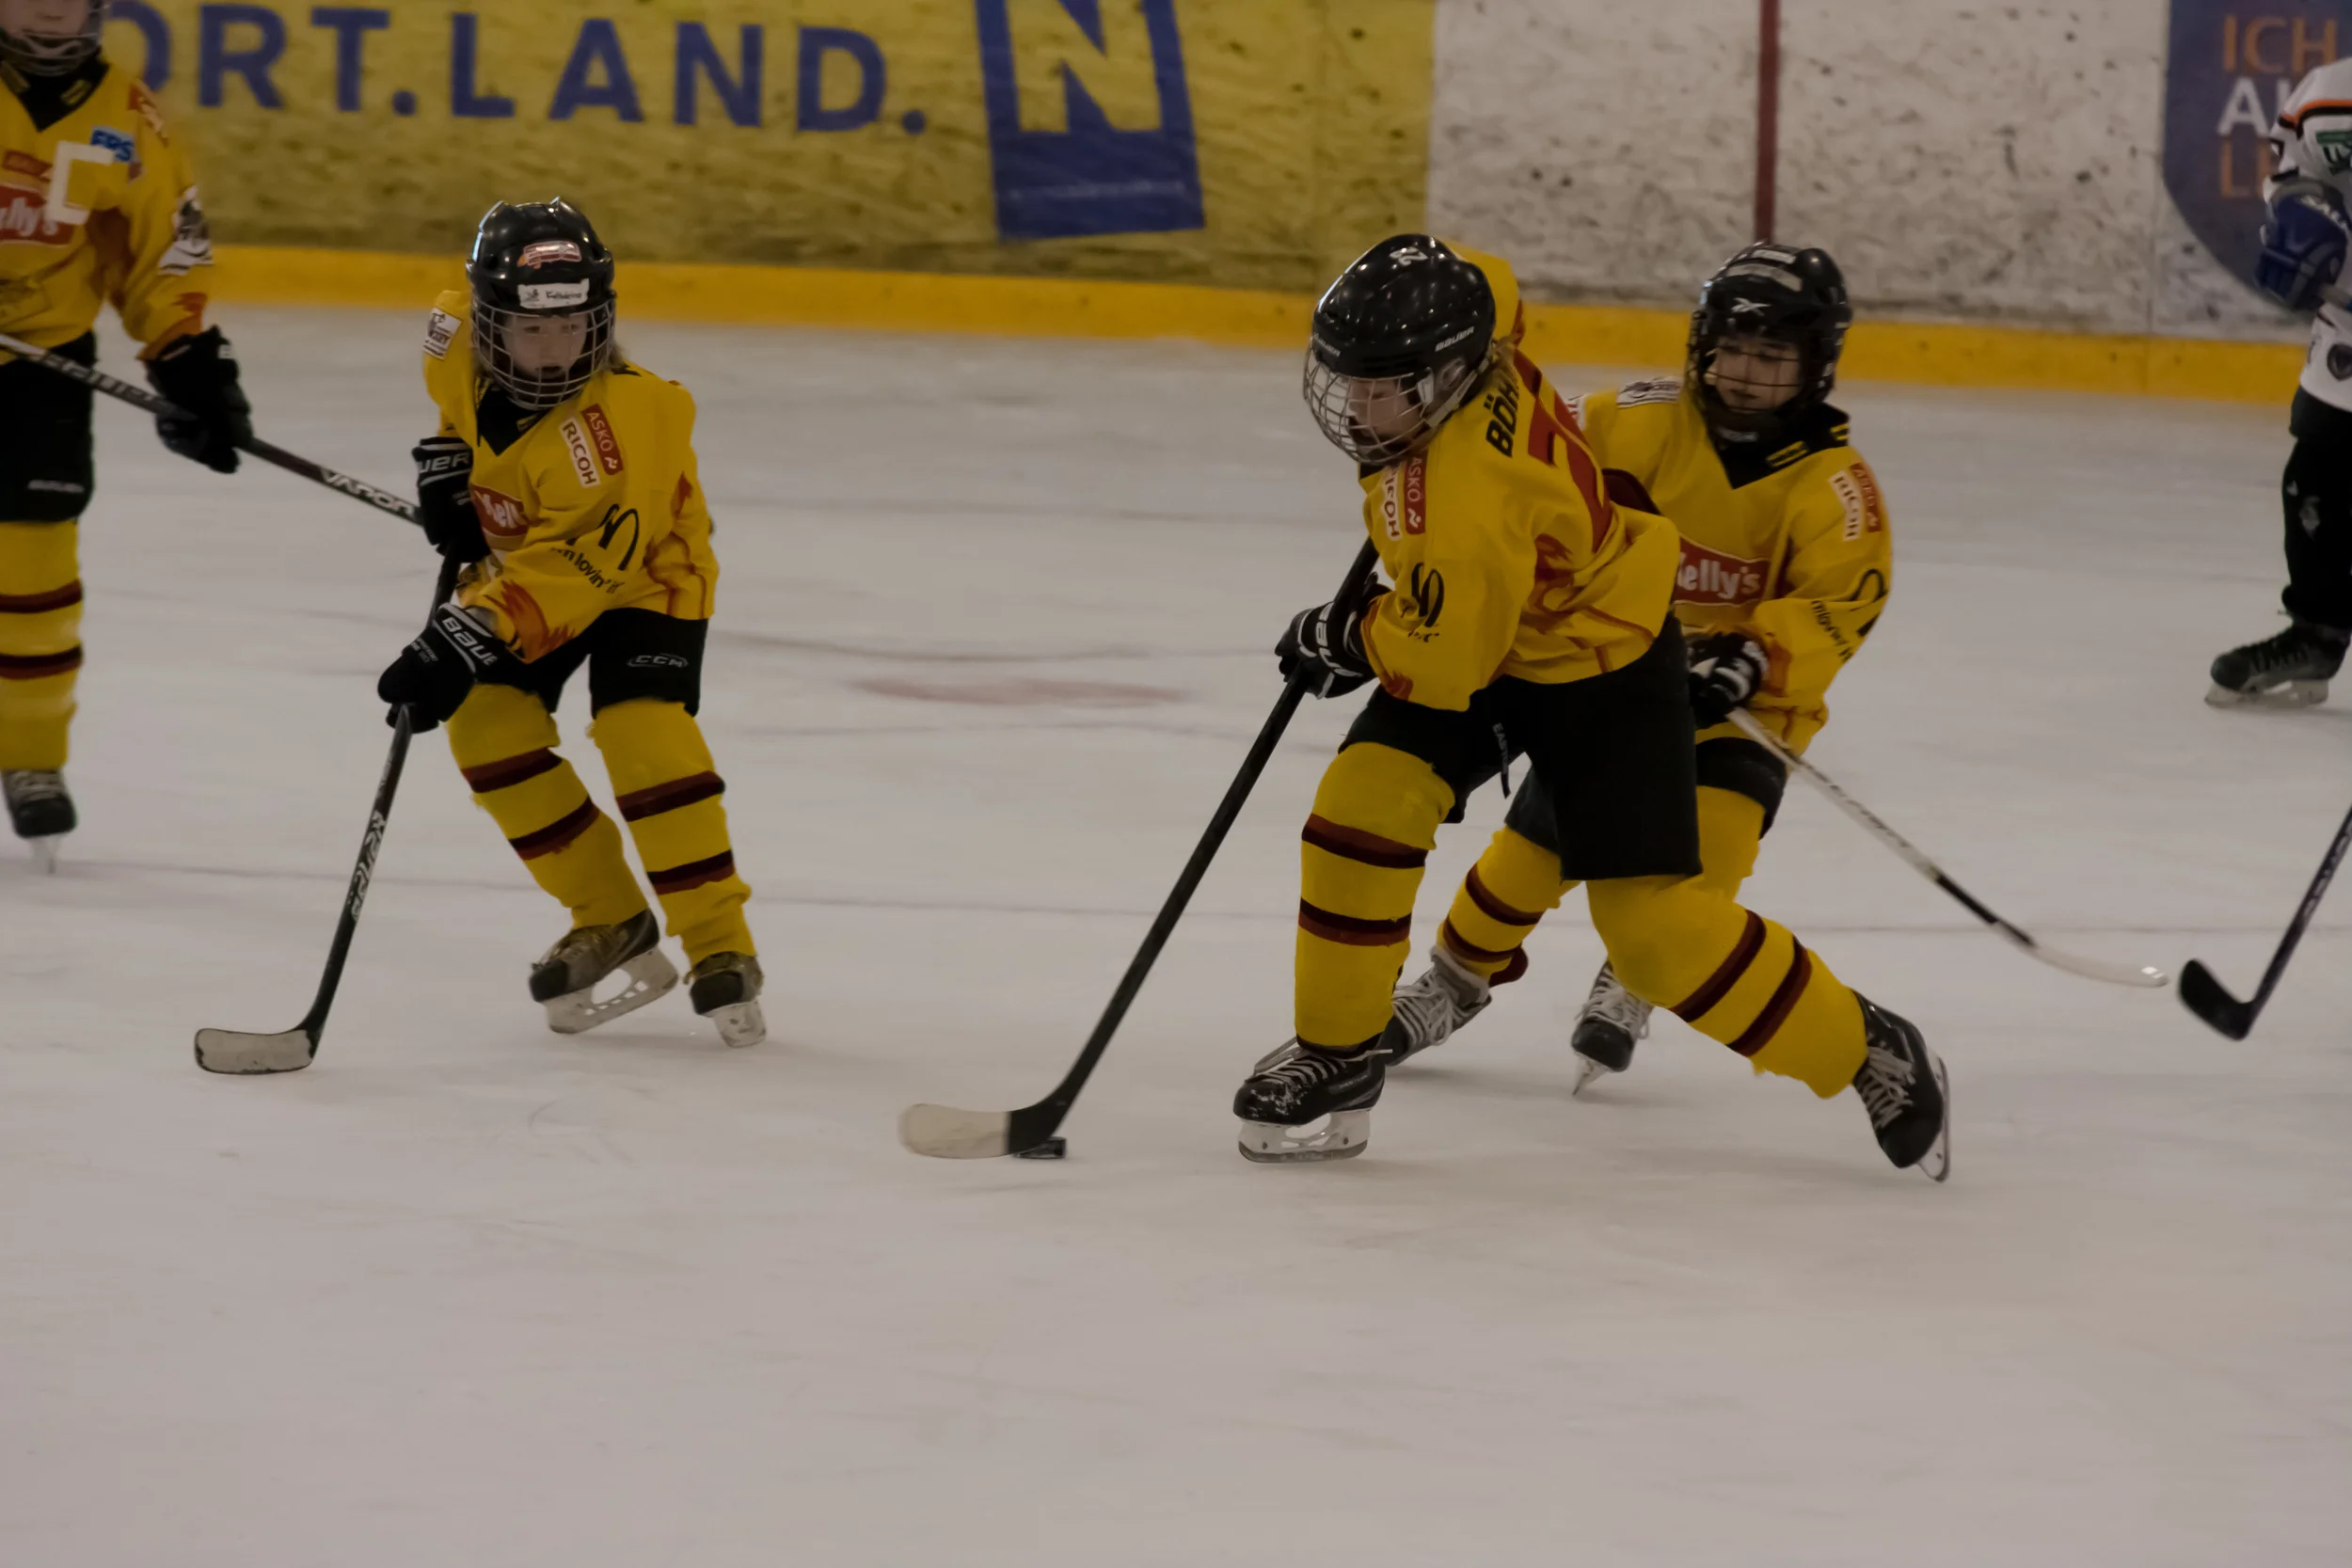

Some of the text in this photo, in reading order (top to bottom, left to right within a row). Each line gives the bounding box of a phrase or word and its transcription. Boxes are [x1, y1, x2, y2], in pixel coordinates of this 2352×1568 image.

[2222, 14, 2338, 74] ICH
[563, 420, 597, 484] RICOH
[586, 412, 614, 452] ASKO
[1406, 457, 1423, 502] ASKO
